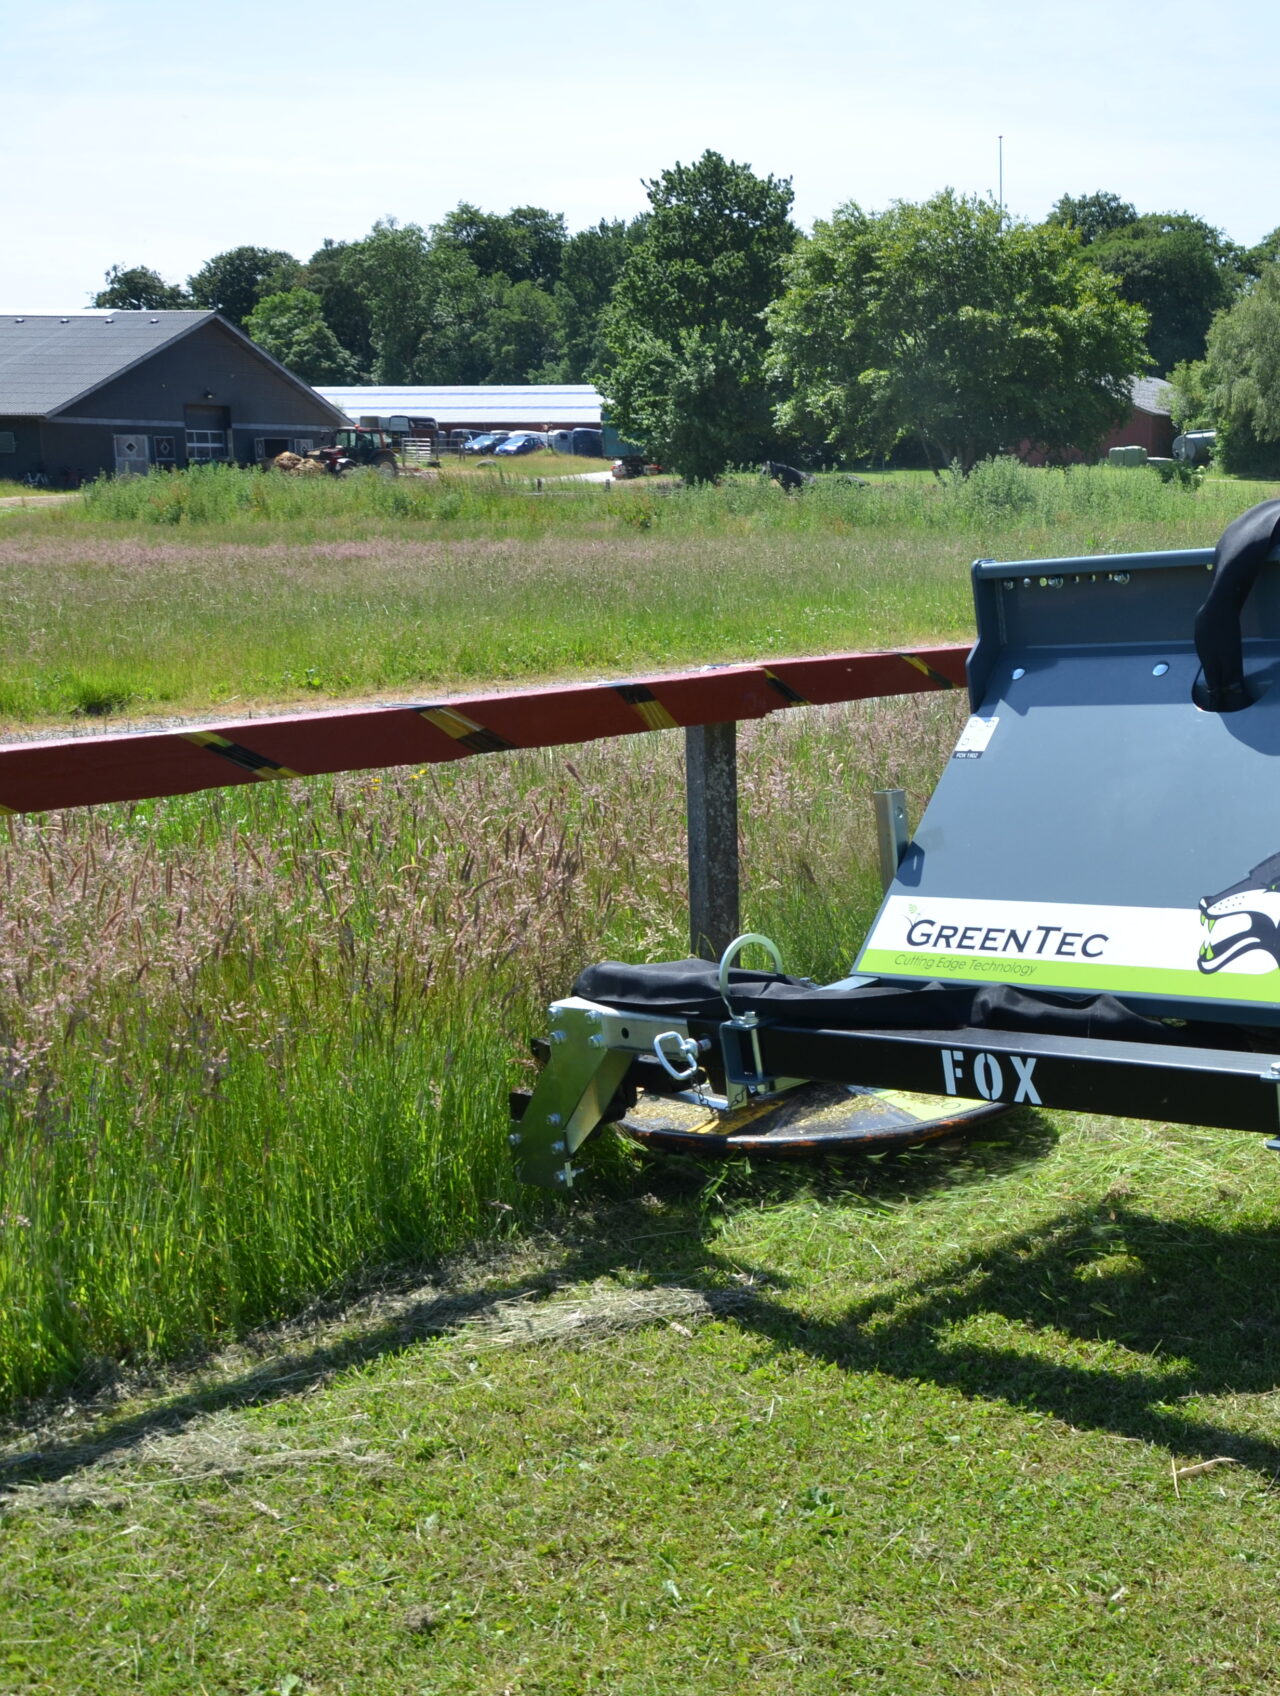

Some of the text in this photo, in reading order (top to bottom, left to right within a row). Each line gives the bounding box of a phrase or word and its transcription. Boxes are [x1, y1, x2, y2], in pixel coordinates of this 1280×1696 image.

[894, 954, 1038, 977] Cutting Edge Technology
[941, 1049, 1042, 1105] FOX
